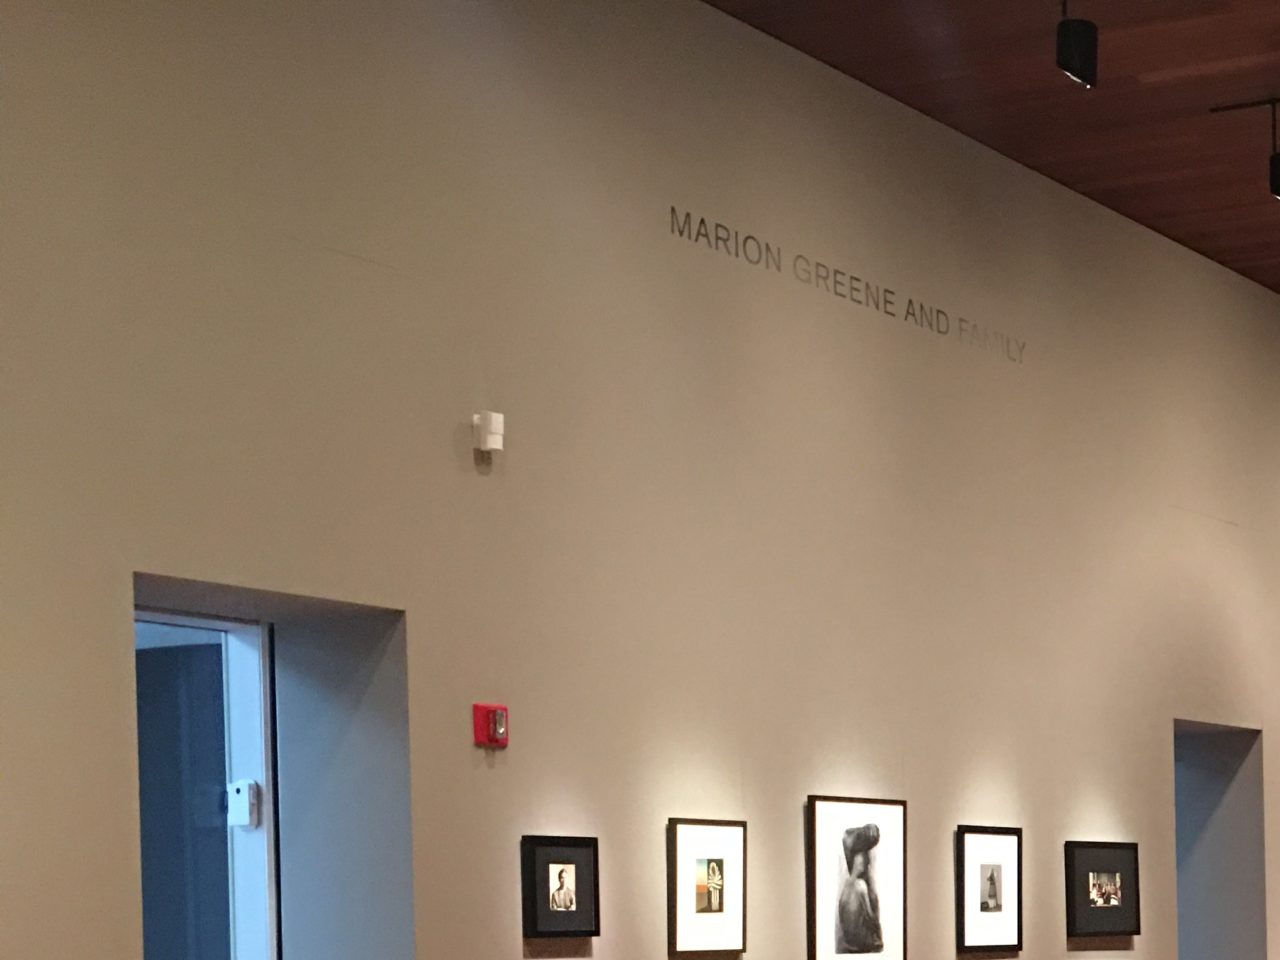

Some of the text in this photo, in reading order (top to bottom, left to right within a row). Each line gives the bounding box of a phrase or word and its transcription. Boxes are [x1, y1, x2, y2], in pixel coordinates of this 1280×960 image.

[669, 206, 782, 273] MARION
[792, 254, 896, 317] GREENE
[904, 299, 950, 334] AND
